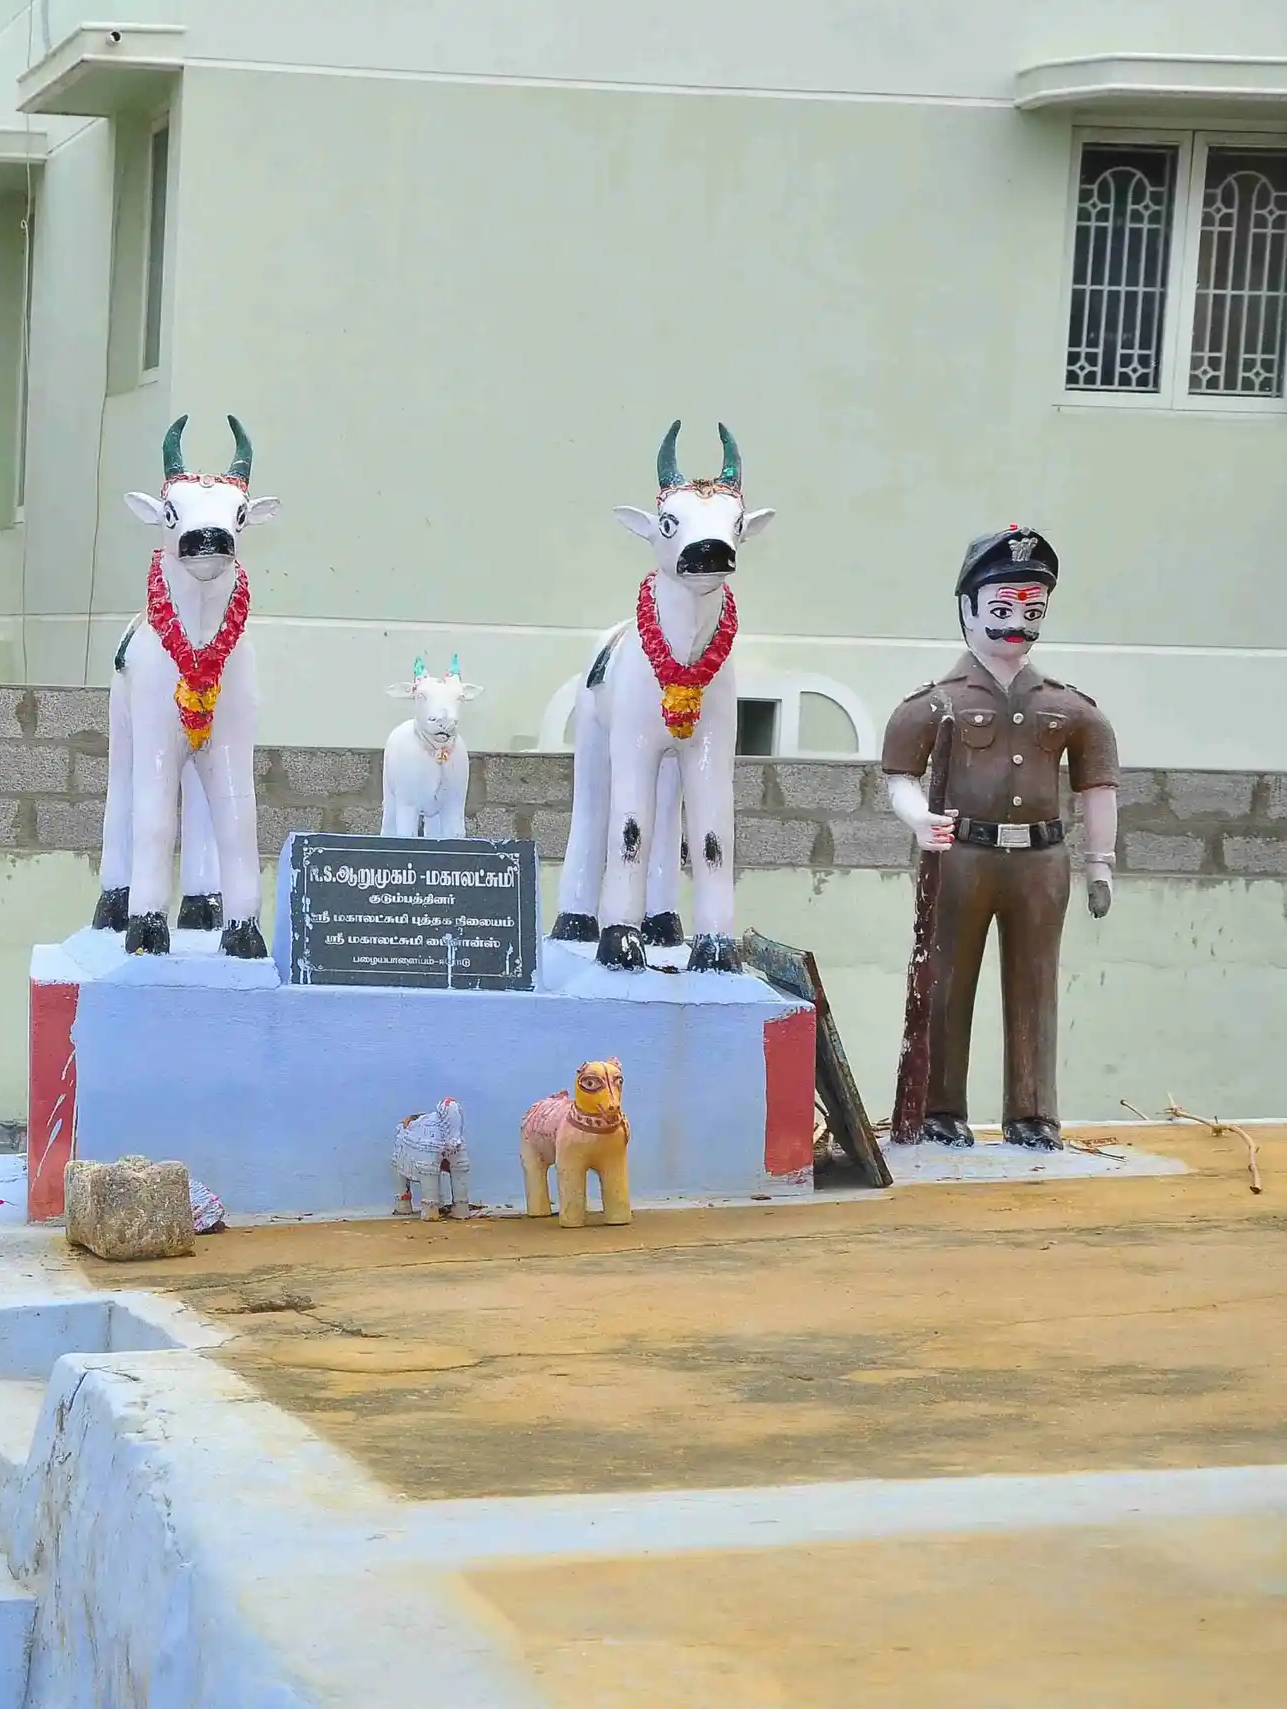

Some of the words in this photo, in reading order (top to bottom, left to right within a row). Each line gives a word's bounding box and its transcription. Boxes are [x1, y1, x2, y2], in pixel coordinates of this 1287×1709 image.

[368, 892, 456, 906] குடும்பத்தினர்
[333, 913, 409, 924] மகாலட்சுமி
[411, 913, 452, 927] புத்தக
[455, 915, 515, 927] நிலையம்
[325, 932, 345, 945] ஸ்ரீ
[347, 935, 423, 947] மகாலட்சுமி
